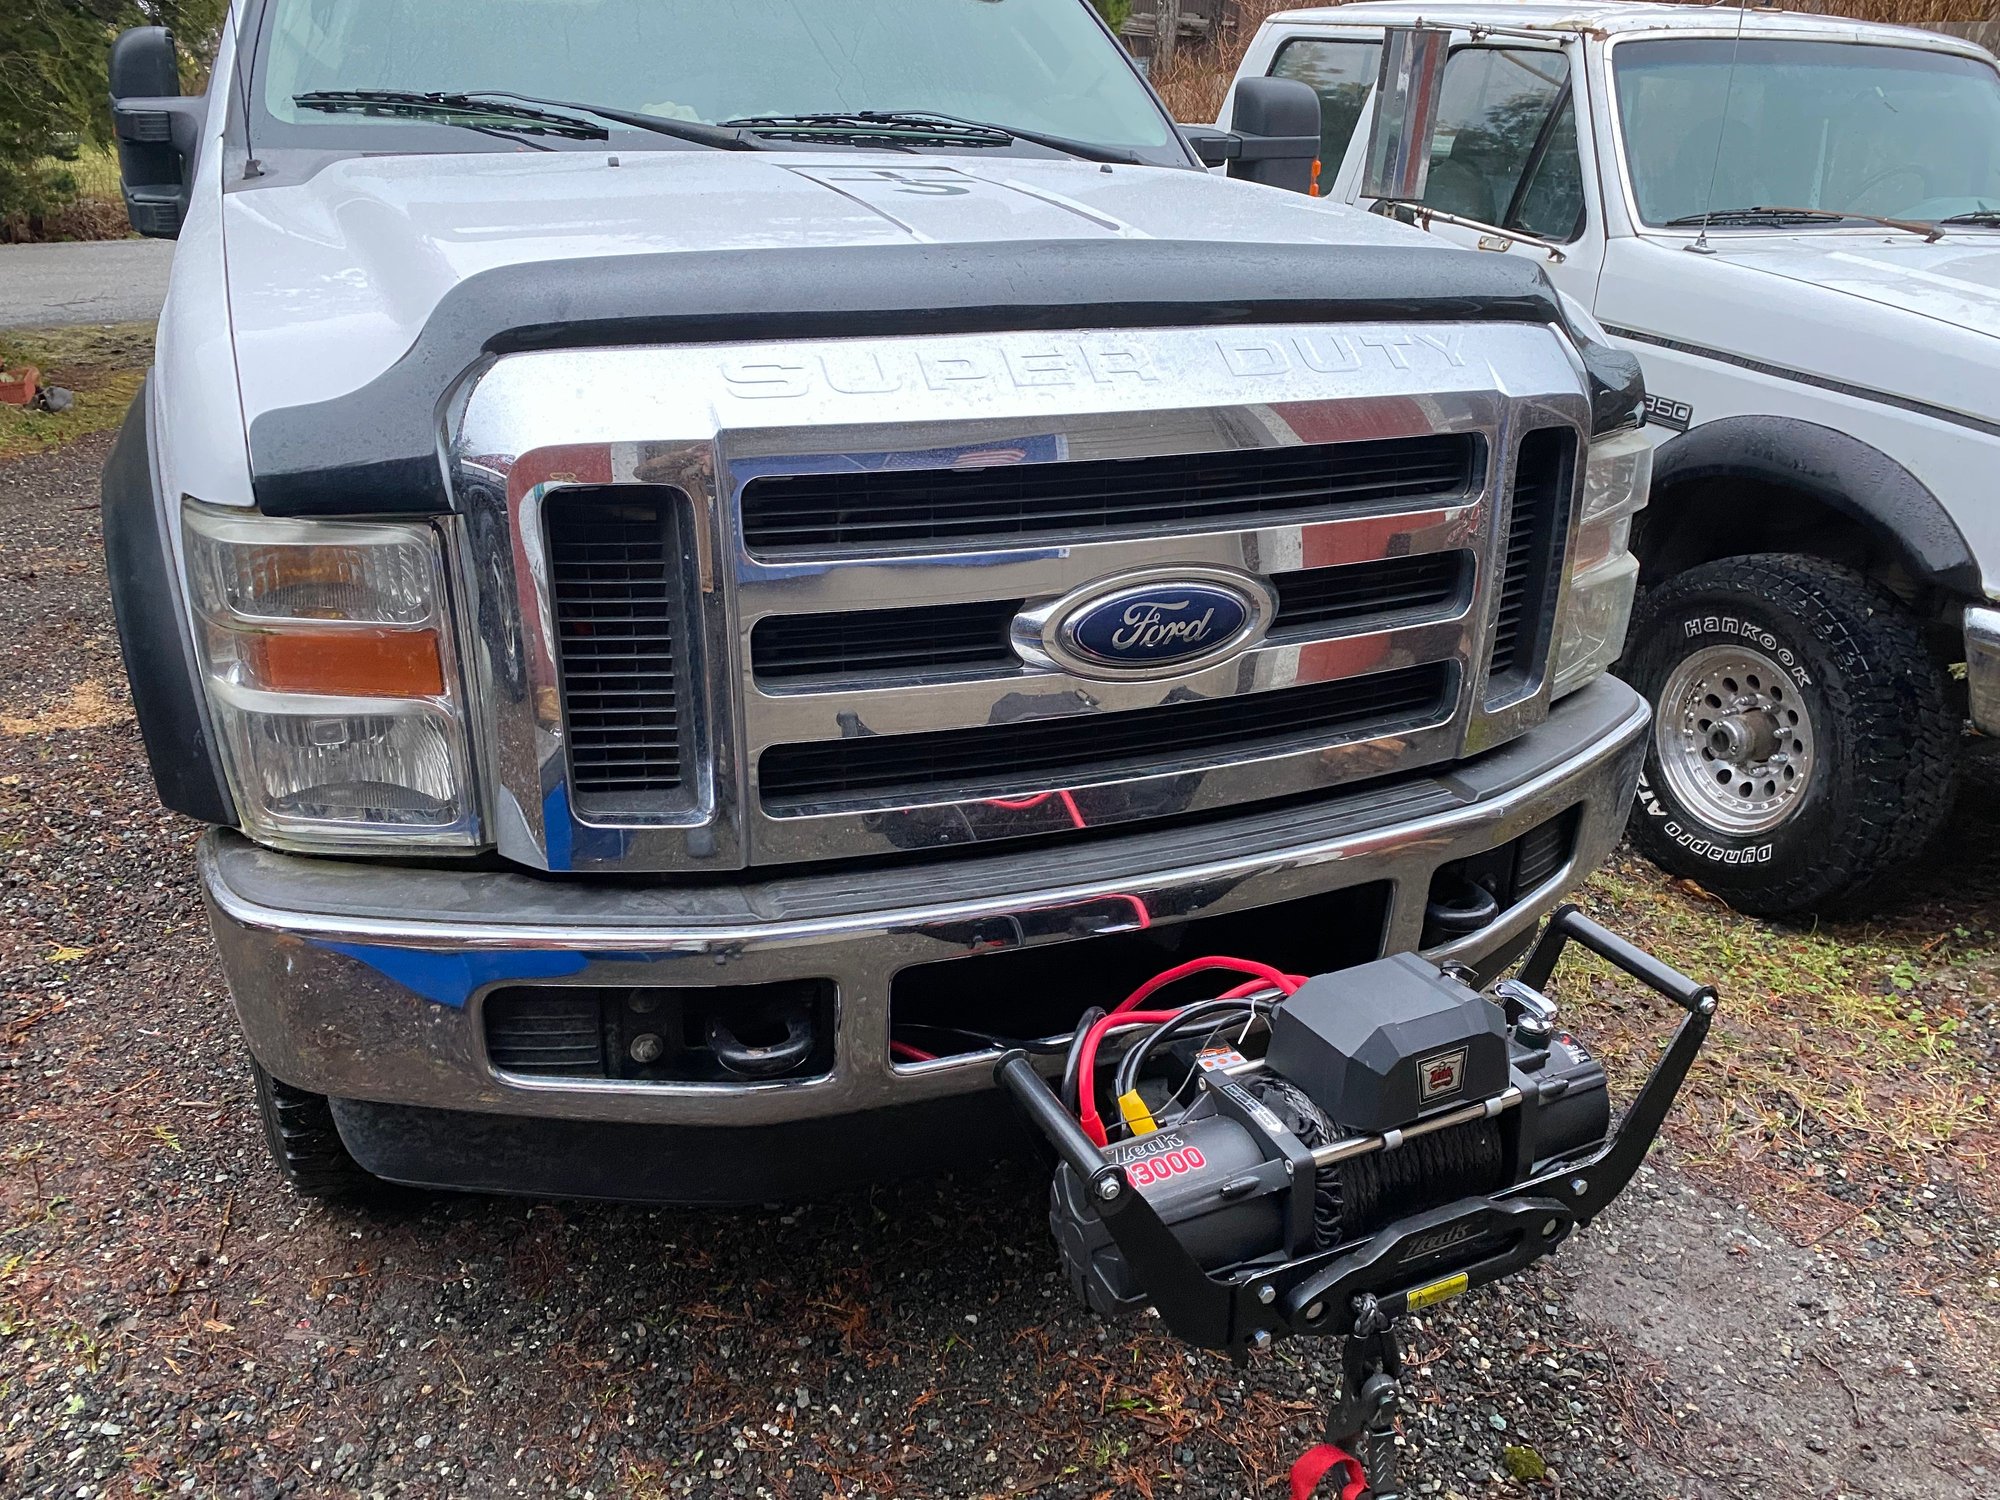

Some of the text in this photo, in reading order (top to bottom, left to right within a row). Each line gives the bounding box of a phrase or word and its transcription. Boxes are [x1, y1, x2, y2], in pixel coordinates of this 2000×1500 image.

[720, 334, 1465, 399] SUPER DUTY
[1645, 394, 1690, 421] 350
[1112, 600, 1214, 649] Ford
[1664, 821, 1773, 864] Dynapro
